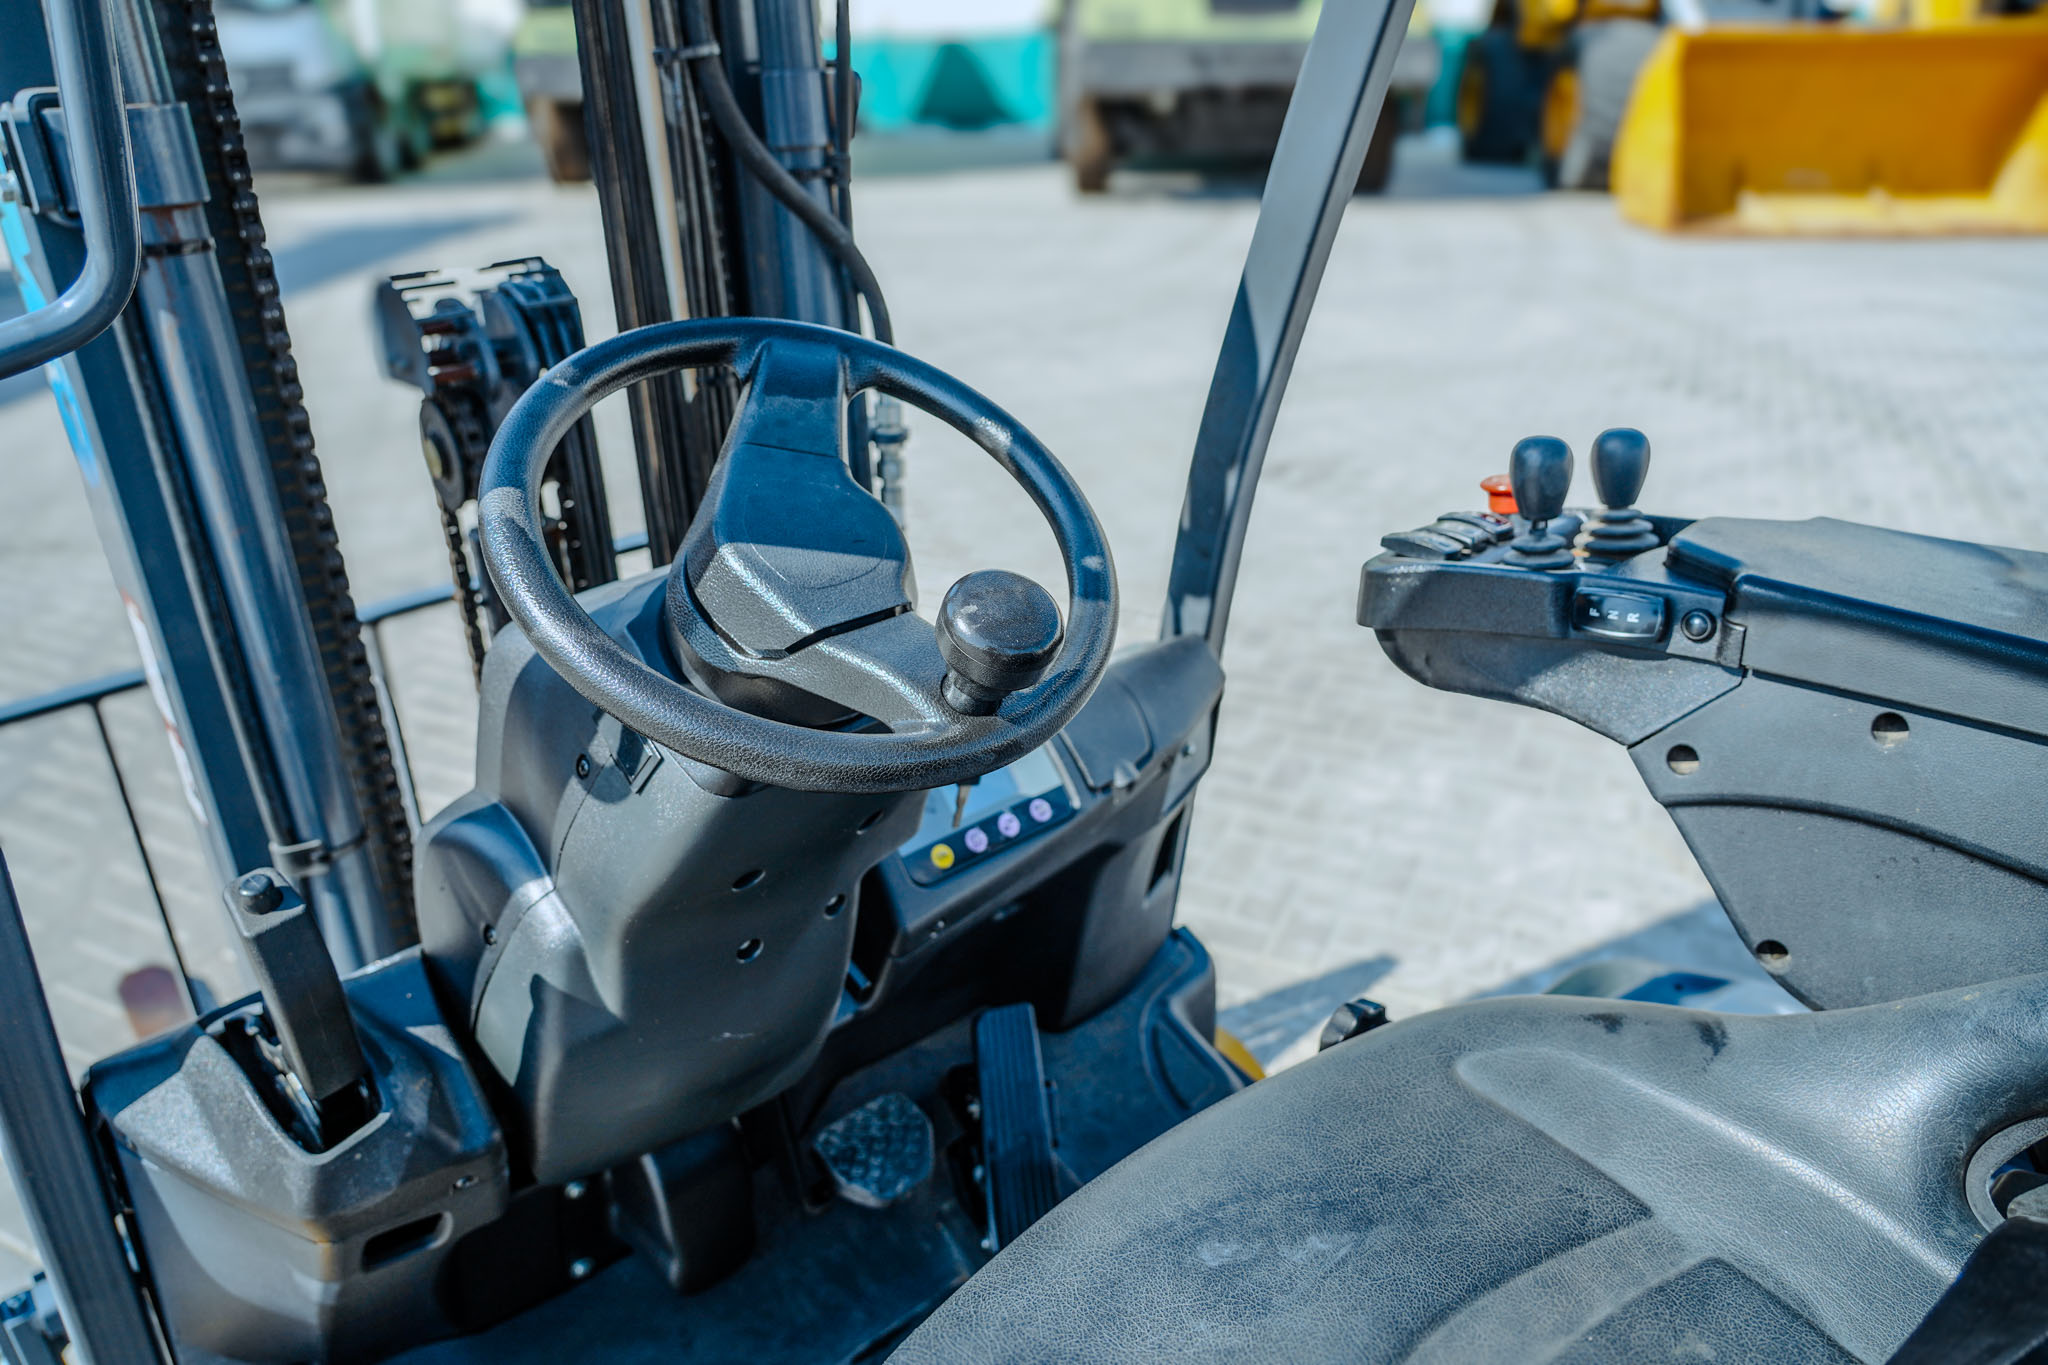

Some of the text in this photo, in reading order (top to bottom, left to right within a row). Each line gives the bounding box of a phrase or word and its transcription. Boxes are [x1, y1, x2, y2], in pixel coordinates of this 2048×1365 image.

[1589, 607, 1640, 623] F N R
